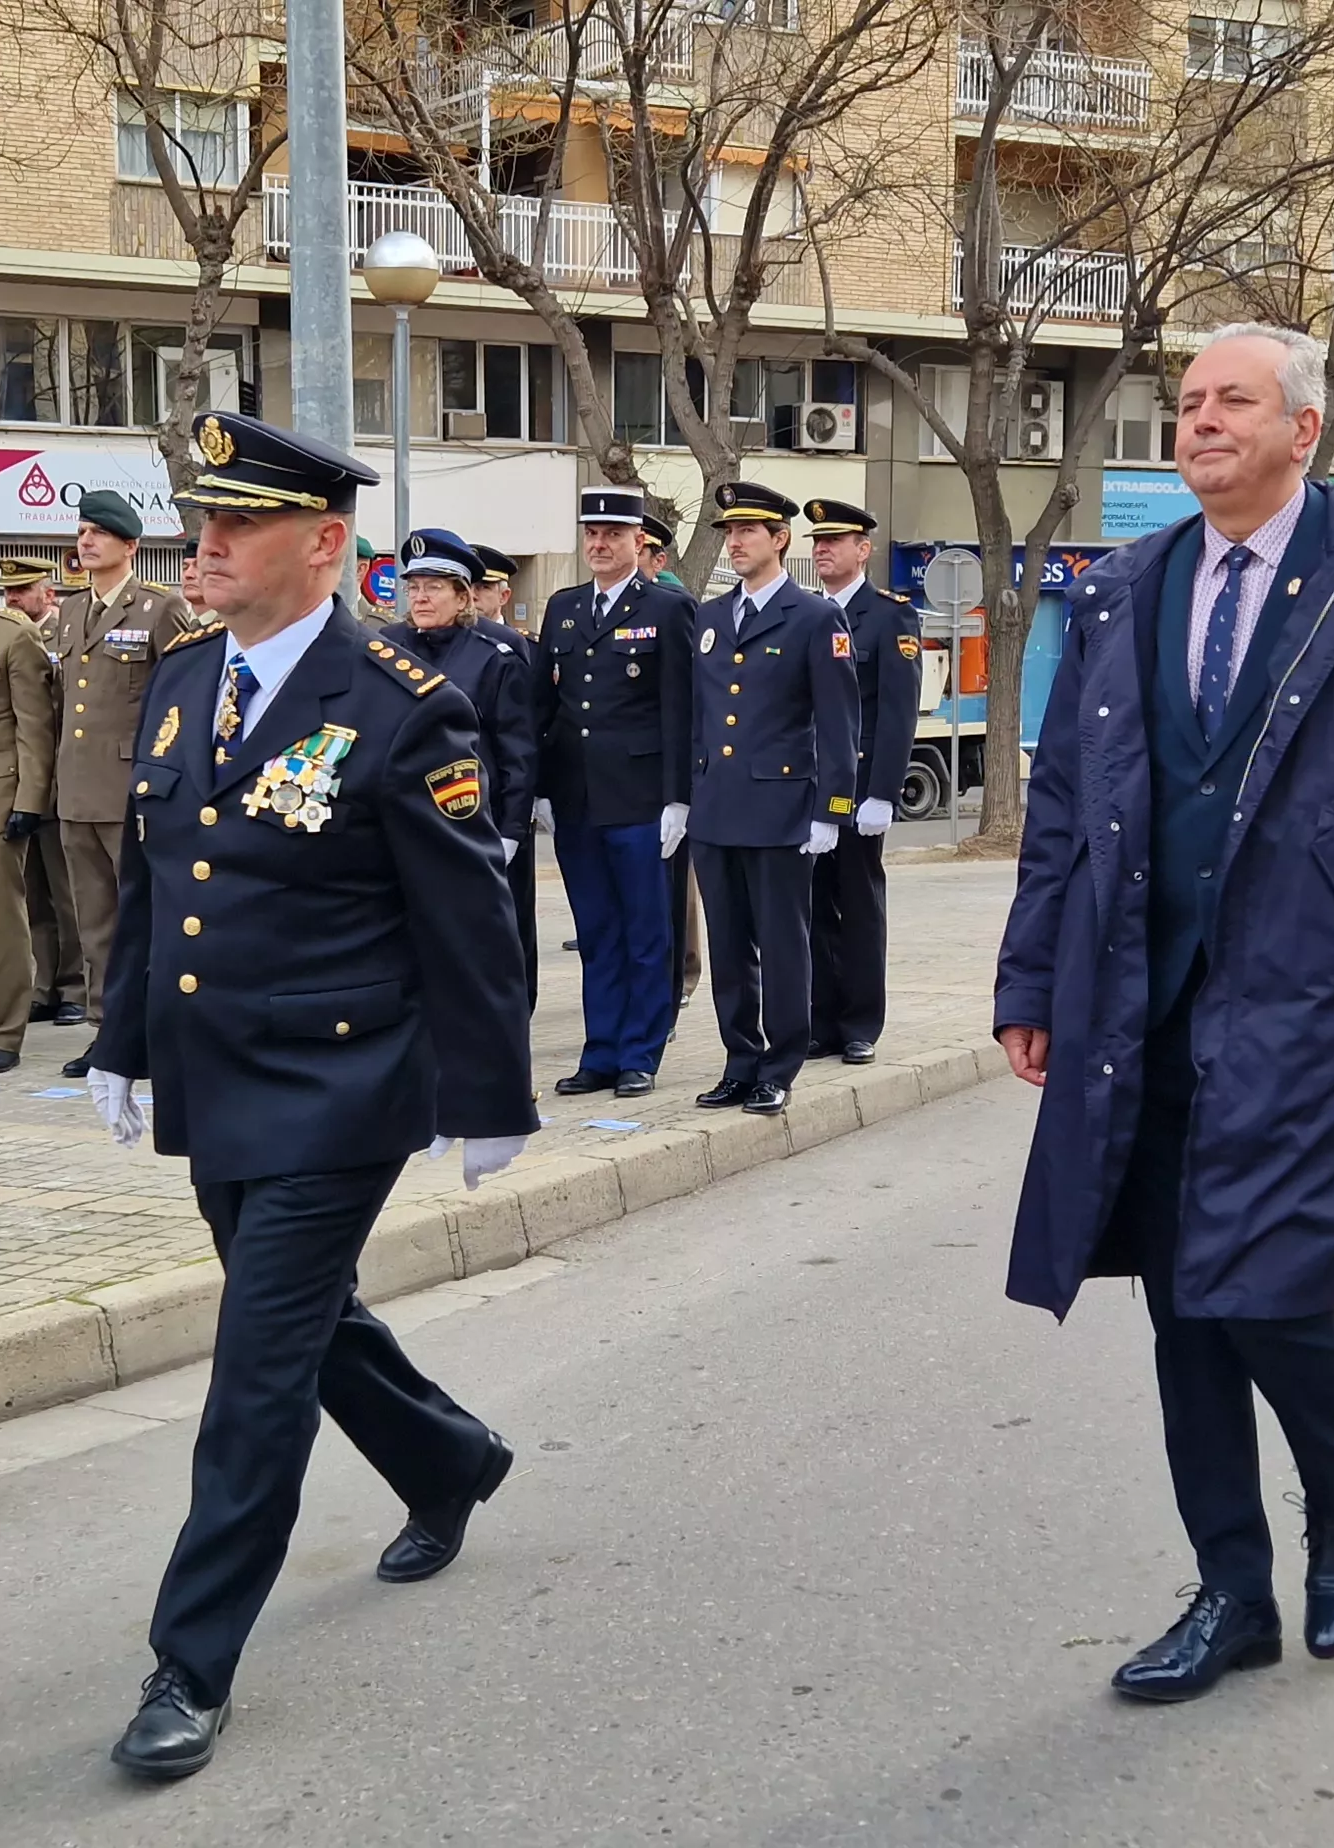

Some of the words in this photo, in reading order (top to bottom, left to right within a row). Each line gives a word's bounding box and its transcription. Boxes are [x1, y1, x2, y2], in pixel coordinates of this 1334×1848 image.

[145, 480, 171, 489] FEDE
[1103, 480, 1191, 494] EXTRAESCOLA
[19, 512, 80, 522] TRABAJAMO
